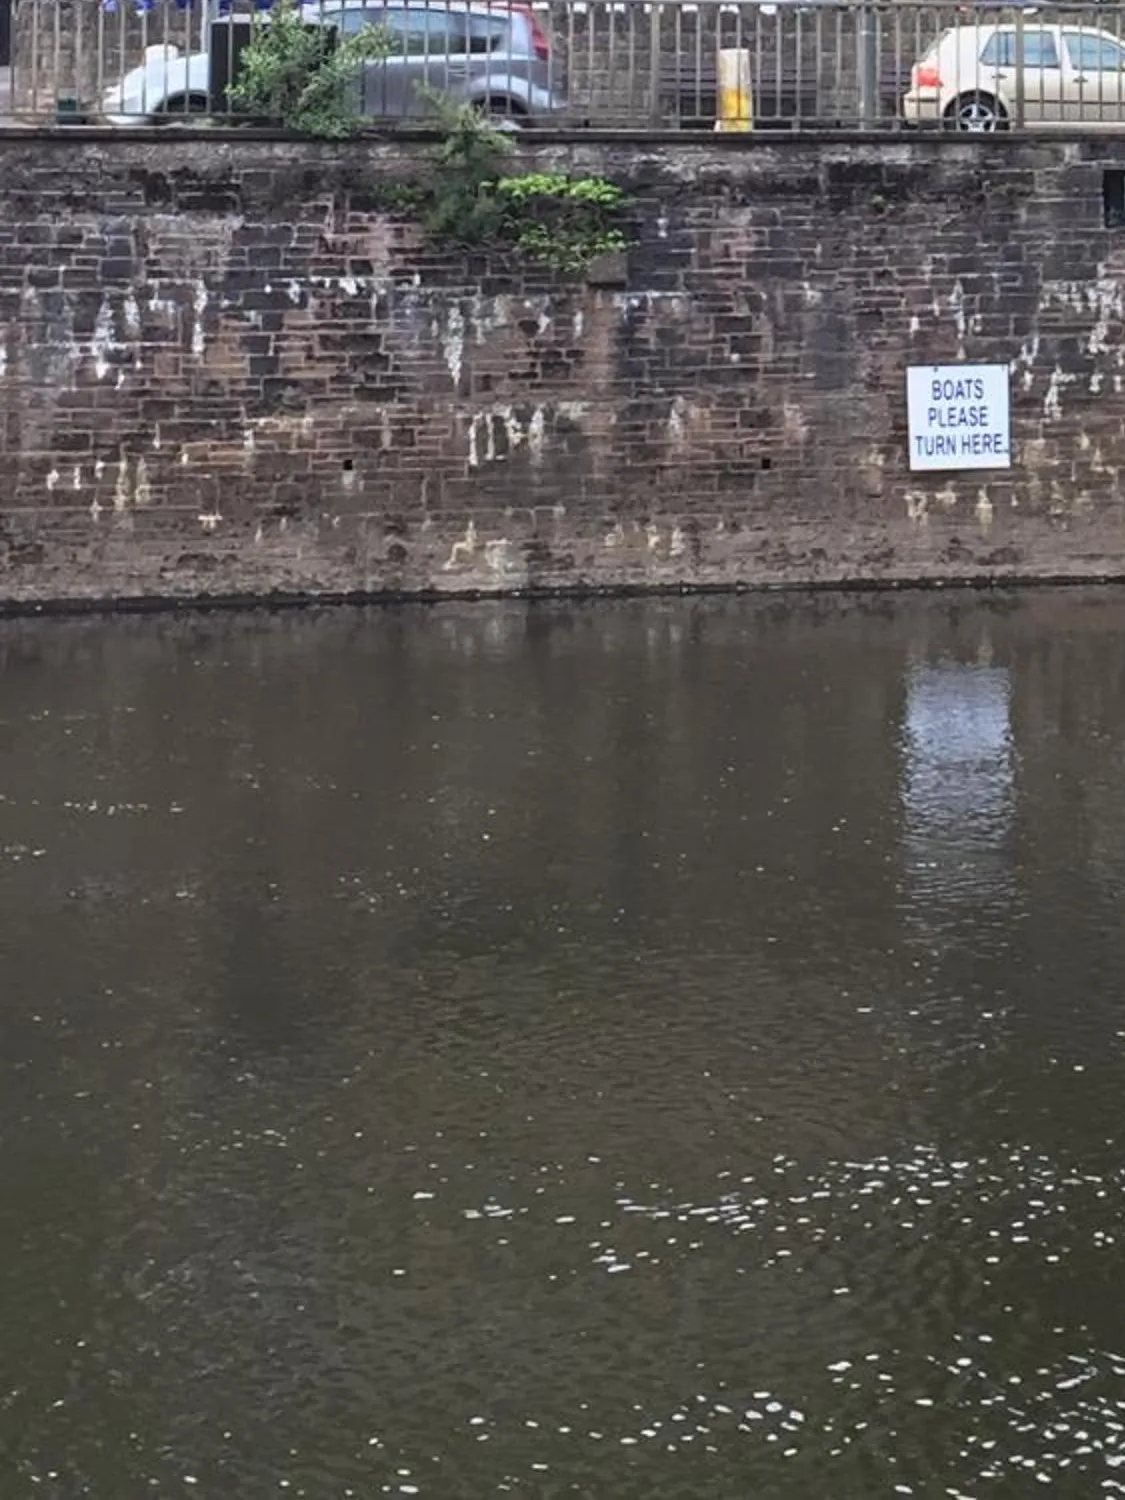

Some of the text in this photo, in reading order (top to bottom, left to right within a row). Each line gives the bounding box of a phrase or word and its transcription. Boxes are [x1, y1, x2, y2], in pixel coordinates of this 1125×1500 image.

[931, 378, 984, 401] BOATS
[928, 406, 989, 428] PLEASE
[915, 435, 956, 456] TURN
